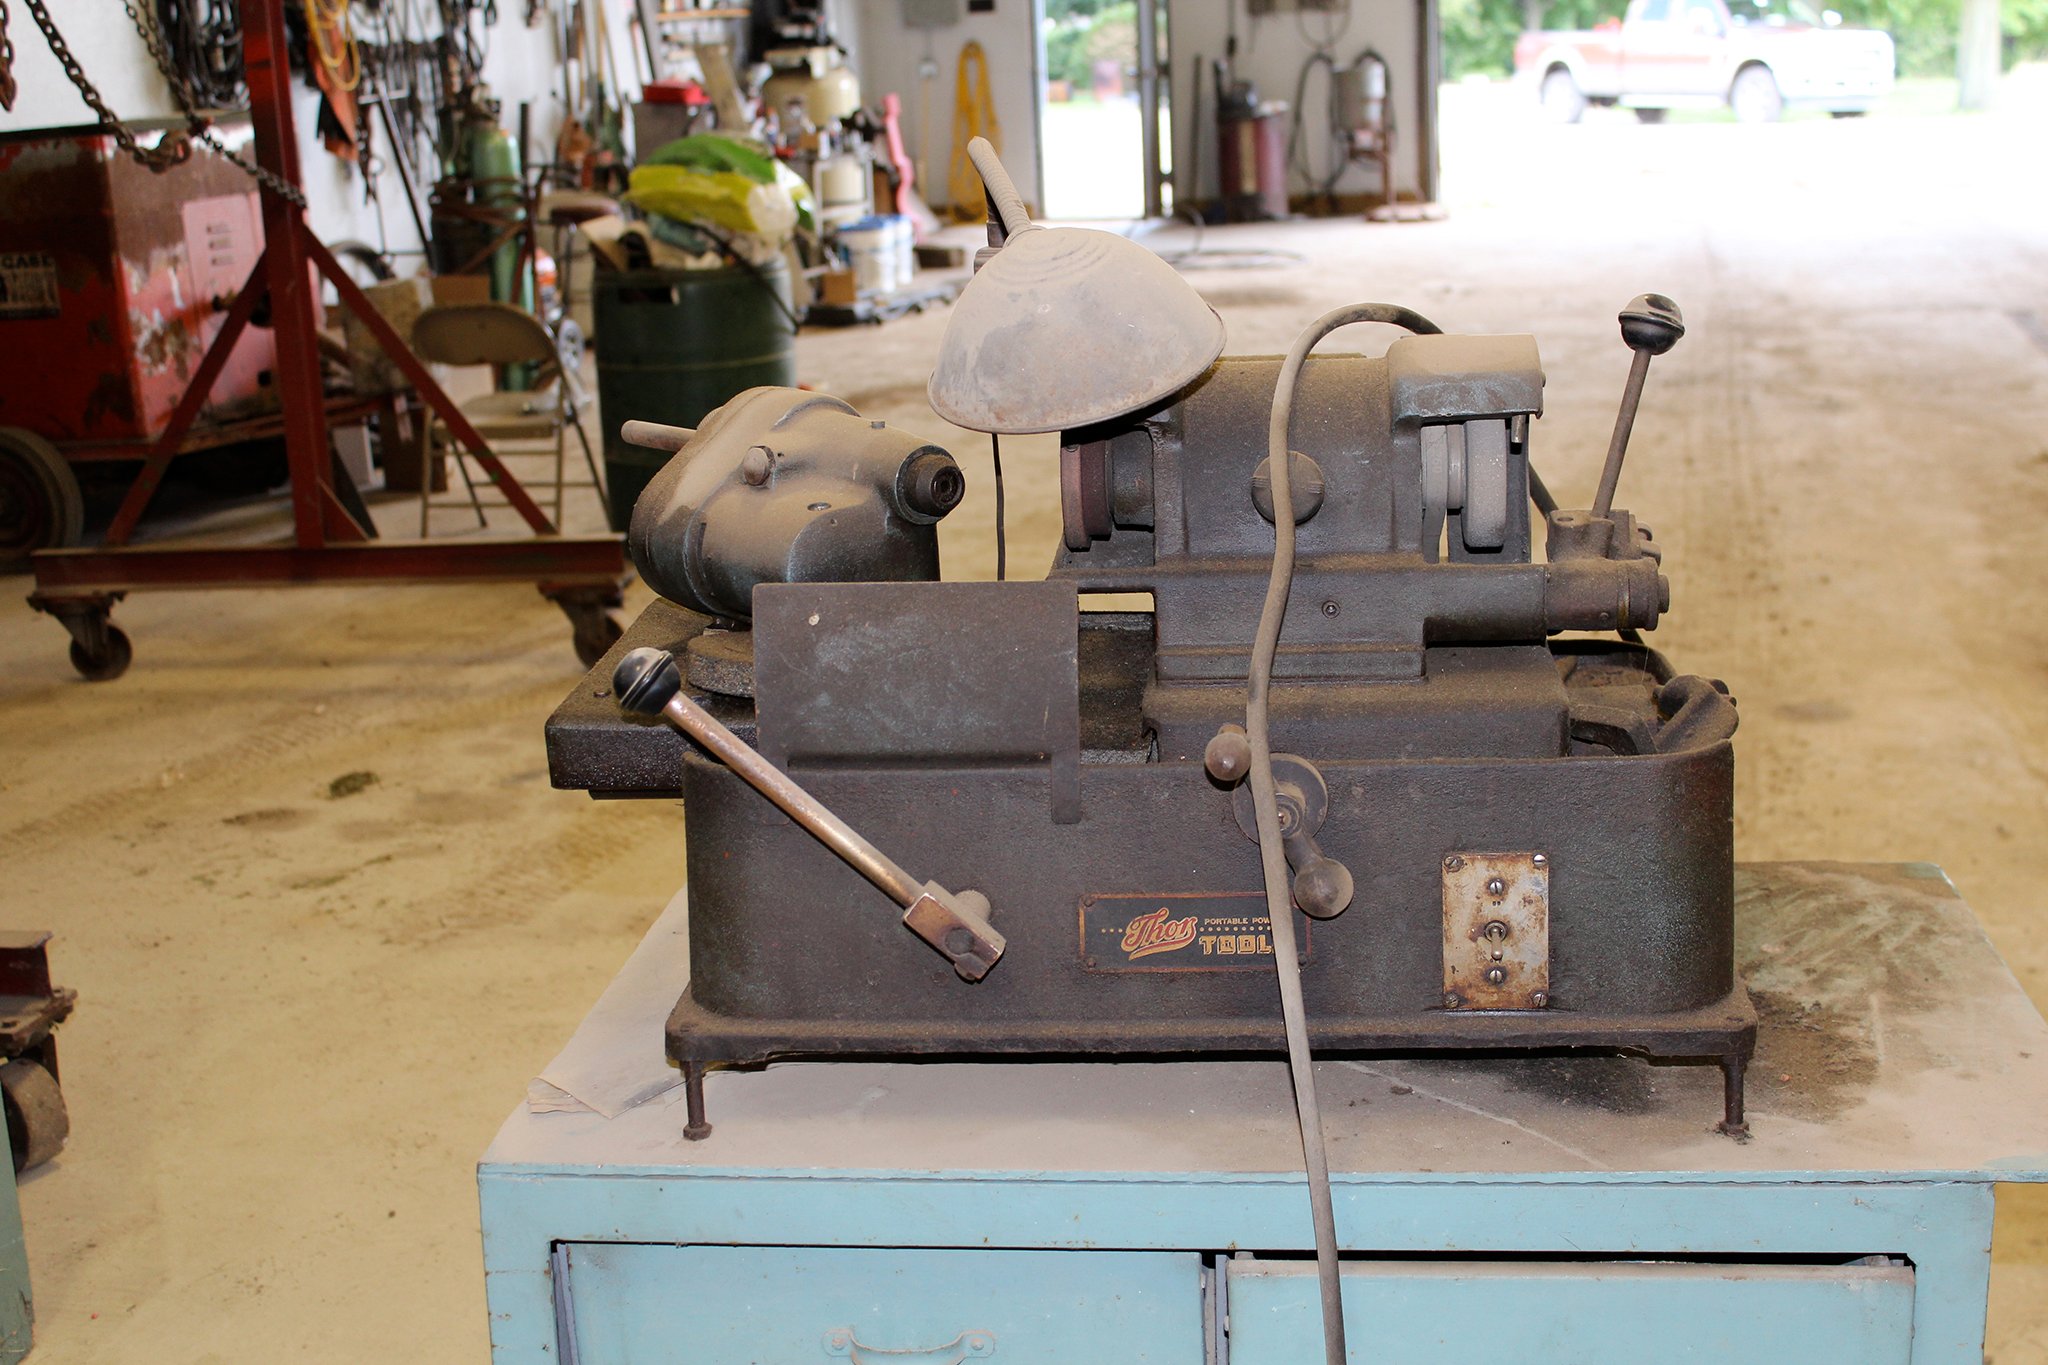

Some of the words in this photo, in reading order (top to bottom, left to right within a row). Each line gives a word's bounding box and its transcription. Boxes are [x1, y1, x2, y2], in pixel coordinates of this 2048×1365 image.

[1204, 917, 1249, 925] PORTABLE
[1252, 917, 1272, 925] POW
[1120, 907, 1198, 957] Thor
[1199, 934, 1276, 955] TOOL
